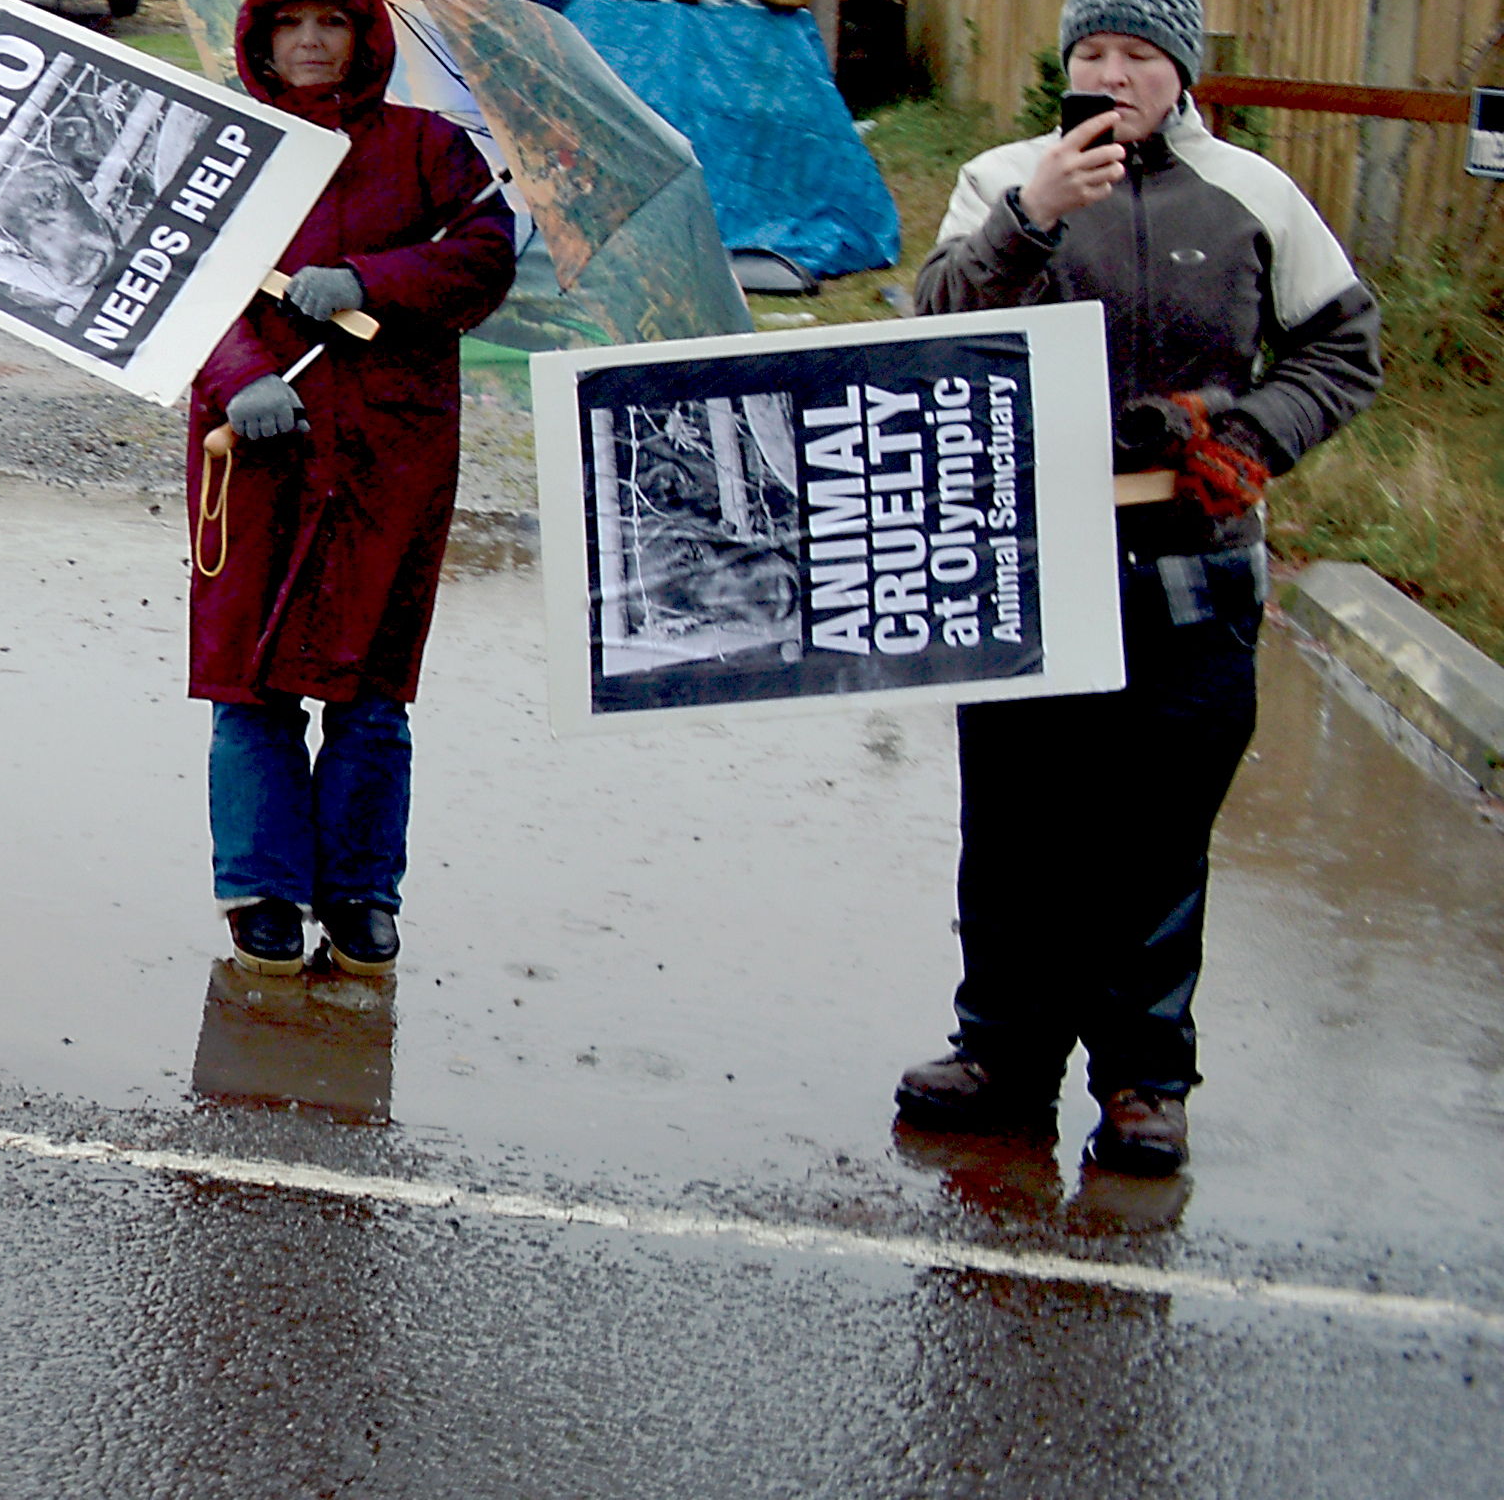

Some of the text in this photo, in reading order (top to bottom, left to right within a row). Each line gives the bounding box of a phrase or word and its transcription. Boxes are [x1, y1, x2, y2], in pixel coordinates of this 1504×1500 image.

[84, 125, 253, 350] NEEDS HELP
[802, 385, 870, 655] ANIMAL
[865, 384, 931, 656] CRUELTY
[925, 376, 985, 647] at Olympic
[988, 374, 1022, 644] Animal Sanctuary
